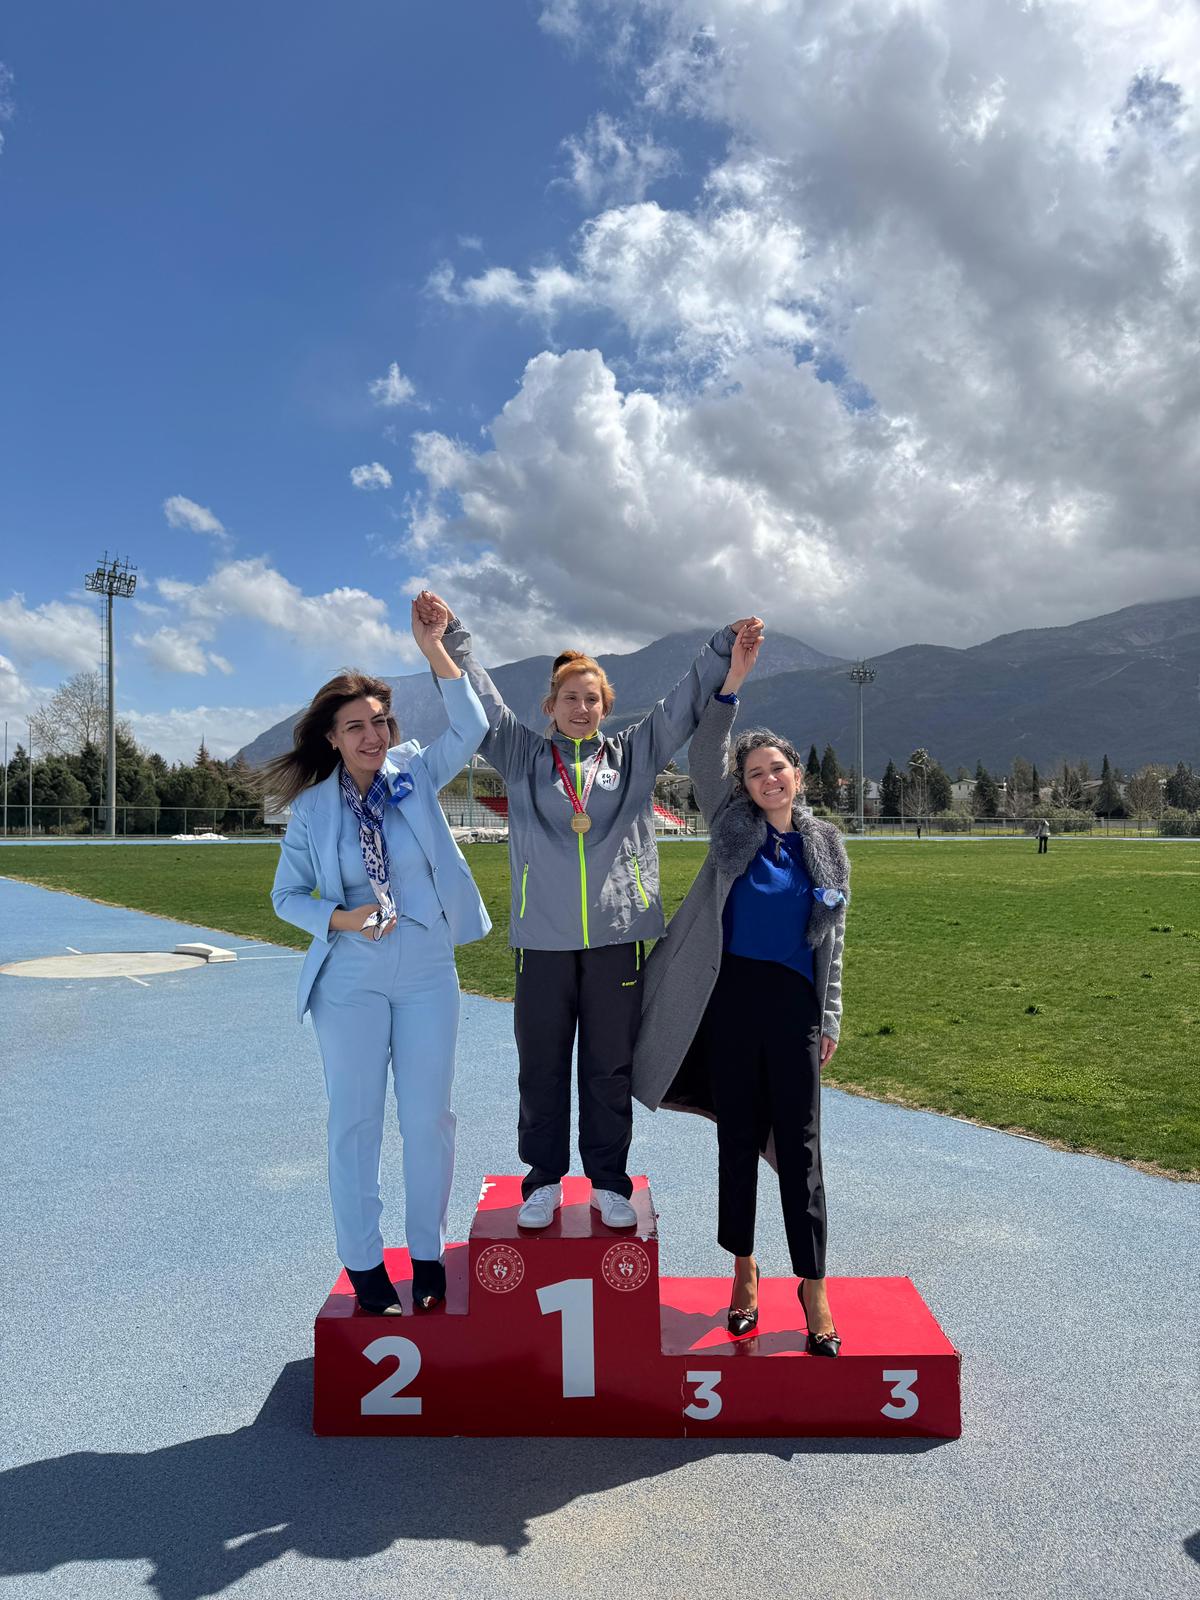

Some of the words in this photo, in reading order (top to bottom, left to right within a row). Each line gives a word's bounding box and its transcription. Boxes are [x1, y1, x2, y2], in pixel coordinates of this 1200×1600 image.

[536, 1279, 596, 1398] 1
[361, 1336, 422, 1416] 2
[683, 1371, 723, 1421] 3
[881, 1370, 919, 1420] 3
